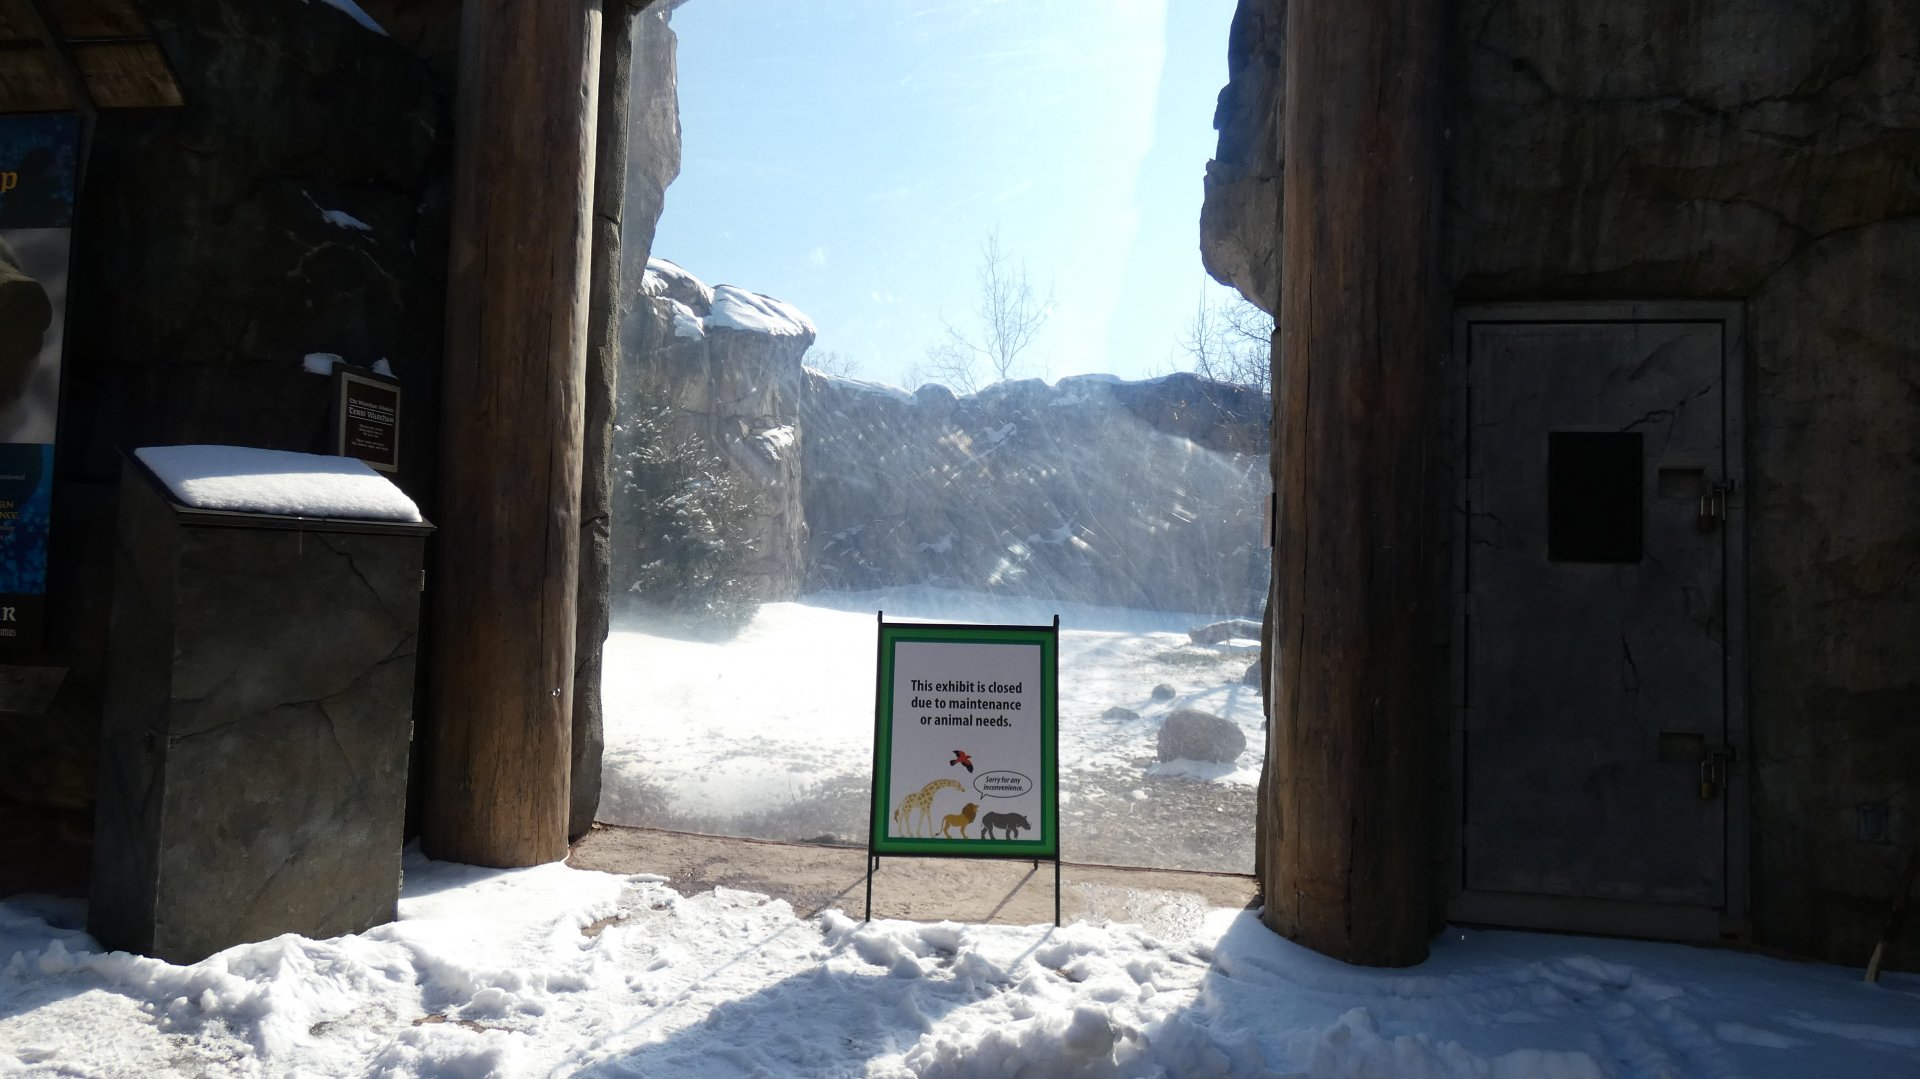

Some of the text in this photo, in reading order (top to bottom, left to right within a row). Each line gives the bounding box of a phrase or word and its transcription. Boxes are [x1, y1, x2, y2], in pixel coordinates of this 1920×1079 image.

[911, 680, 1022, 694] This exhibit is closed
[911, 696, 1022, 711] due to maintenance
[920, 714, 1012, 727] or animal needs.
[985, 776, 1001, 785] Sorry
[983, 784, 1024, 792] inconvenience.
